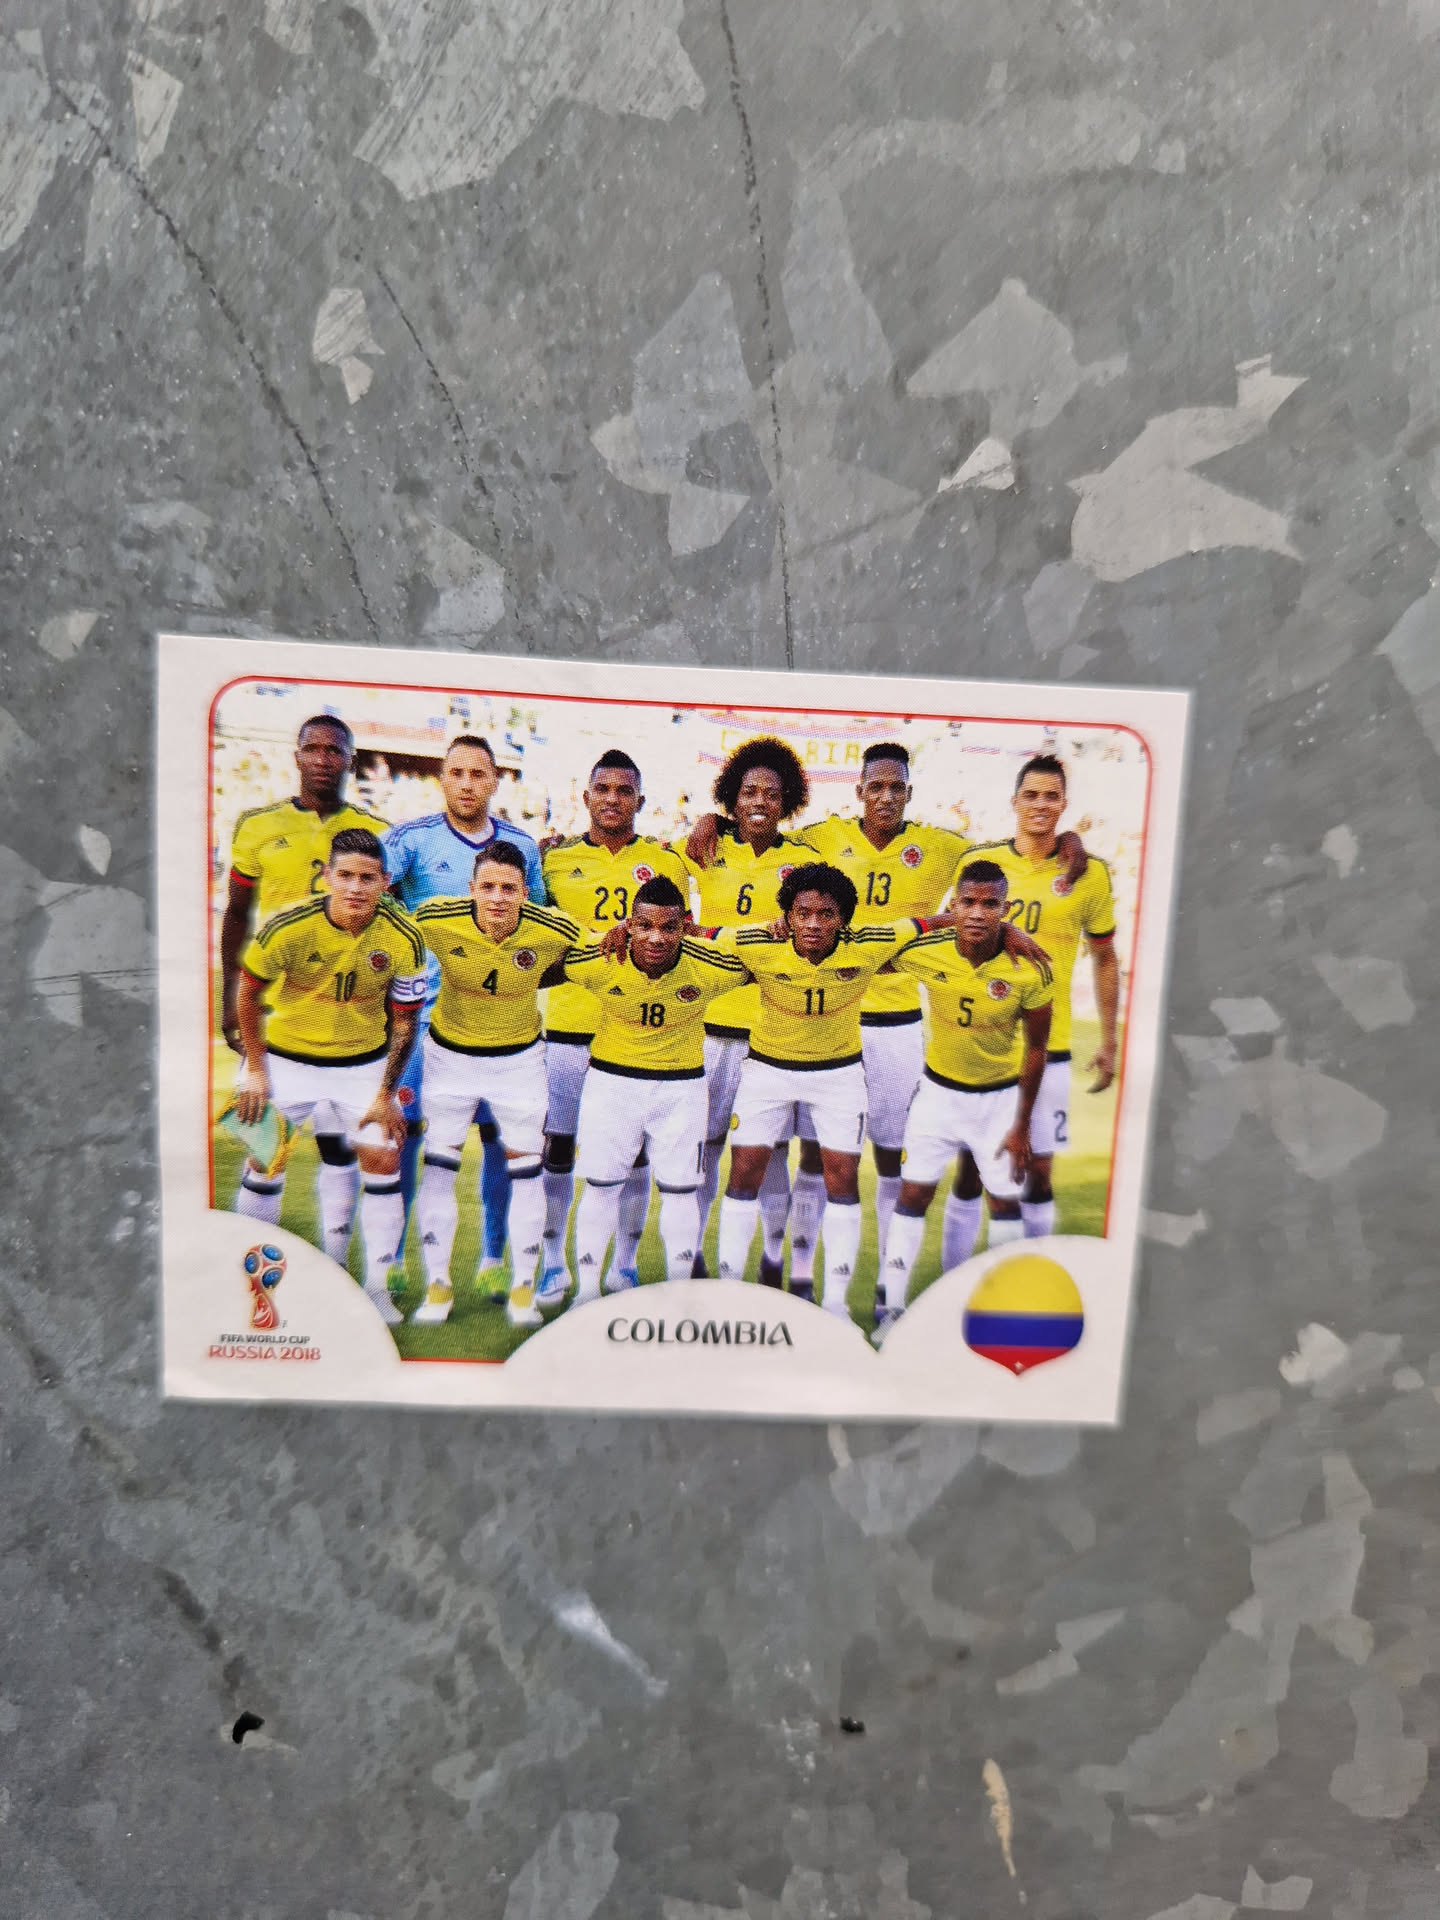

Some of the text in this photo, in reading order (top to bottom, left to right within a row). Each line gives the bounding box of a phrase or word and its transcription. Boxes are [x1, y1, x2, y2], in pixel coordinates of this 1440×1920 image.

[594, 886, 628, 921] 23
[736, 884, 752, 916] 6
[865, 872, 891, 906] 13
[1009, 898, 1041, 934] 20
[335, 970, 357, 1002] 10
[482, 969, 498, 996] 4
[639, 1002, 665, 1028] 18
[804, 987, 825, 1016] 11
[957, 997, 974, 1028] 5
[1053, 1109, 1067, 1142] 2
[220, 1333, 311, 1344] FIFA WORLD CUP
[607, 1317, 794, 1346] COLOMBIA
[208, 1344, 321, 1360] RUSSIA 2018
